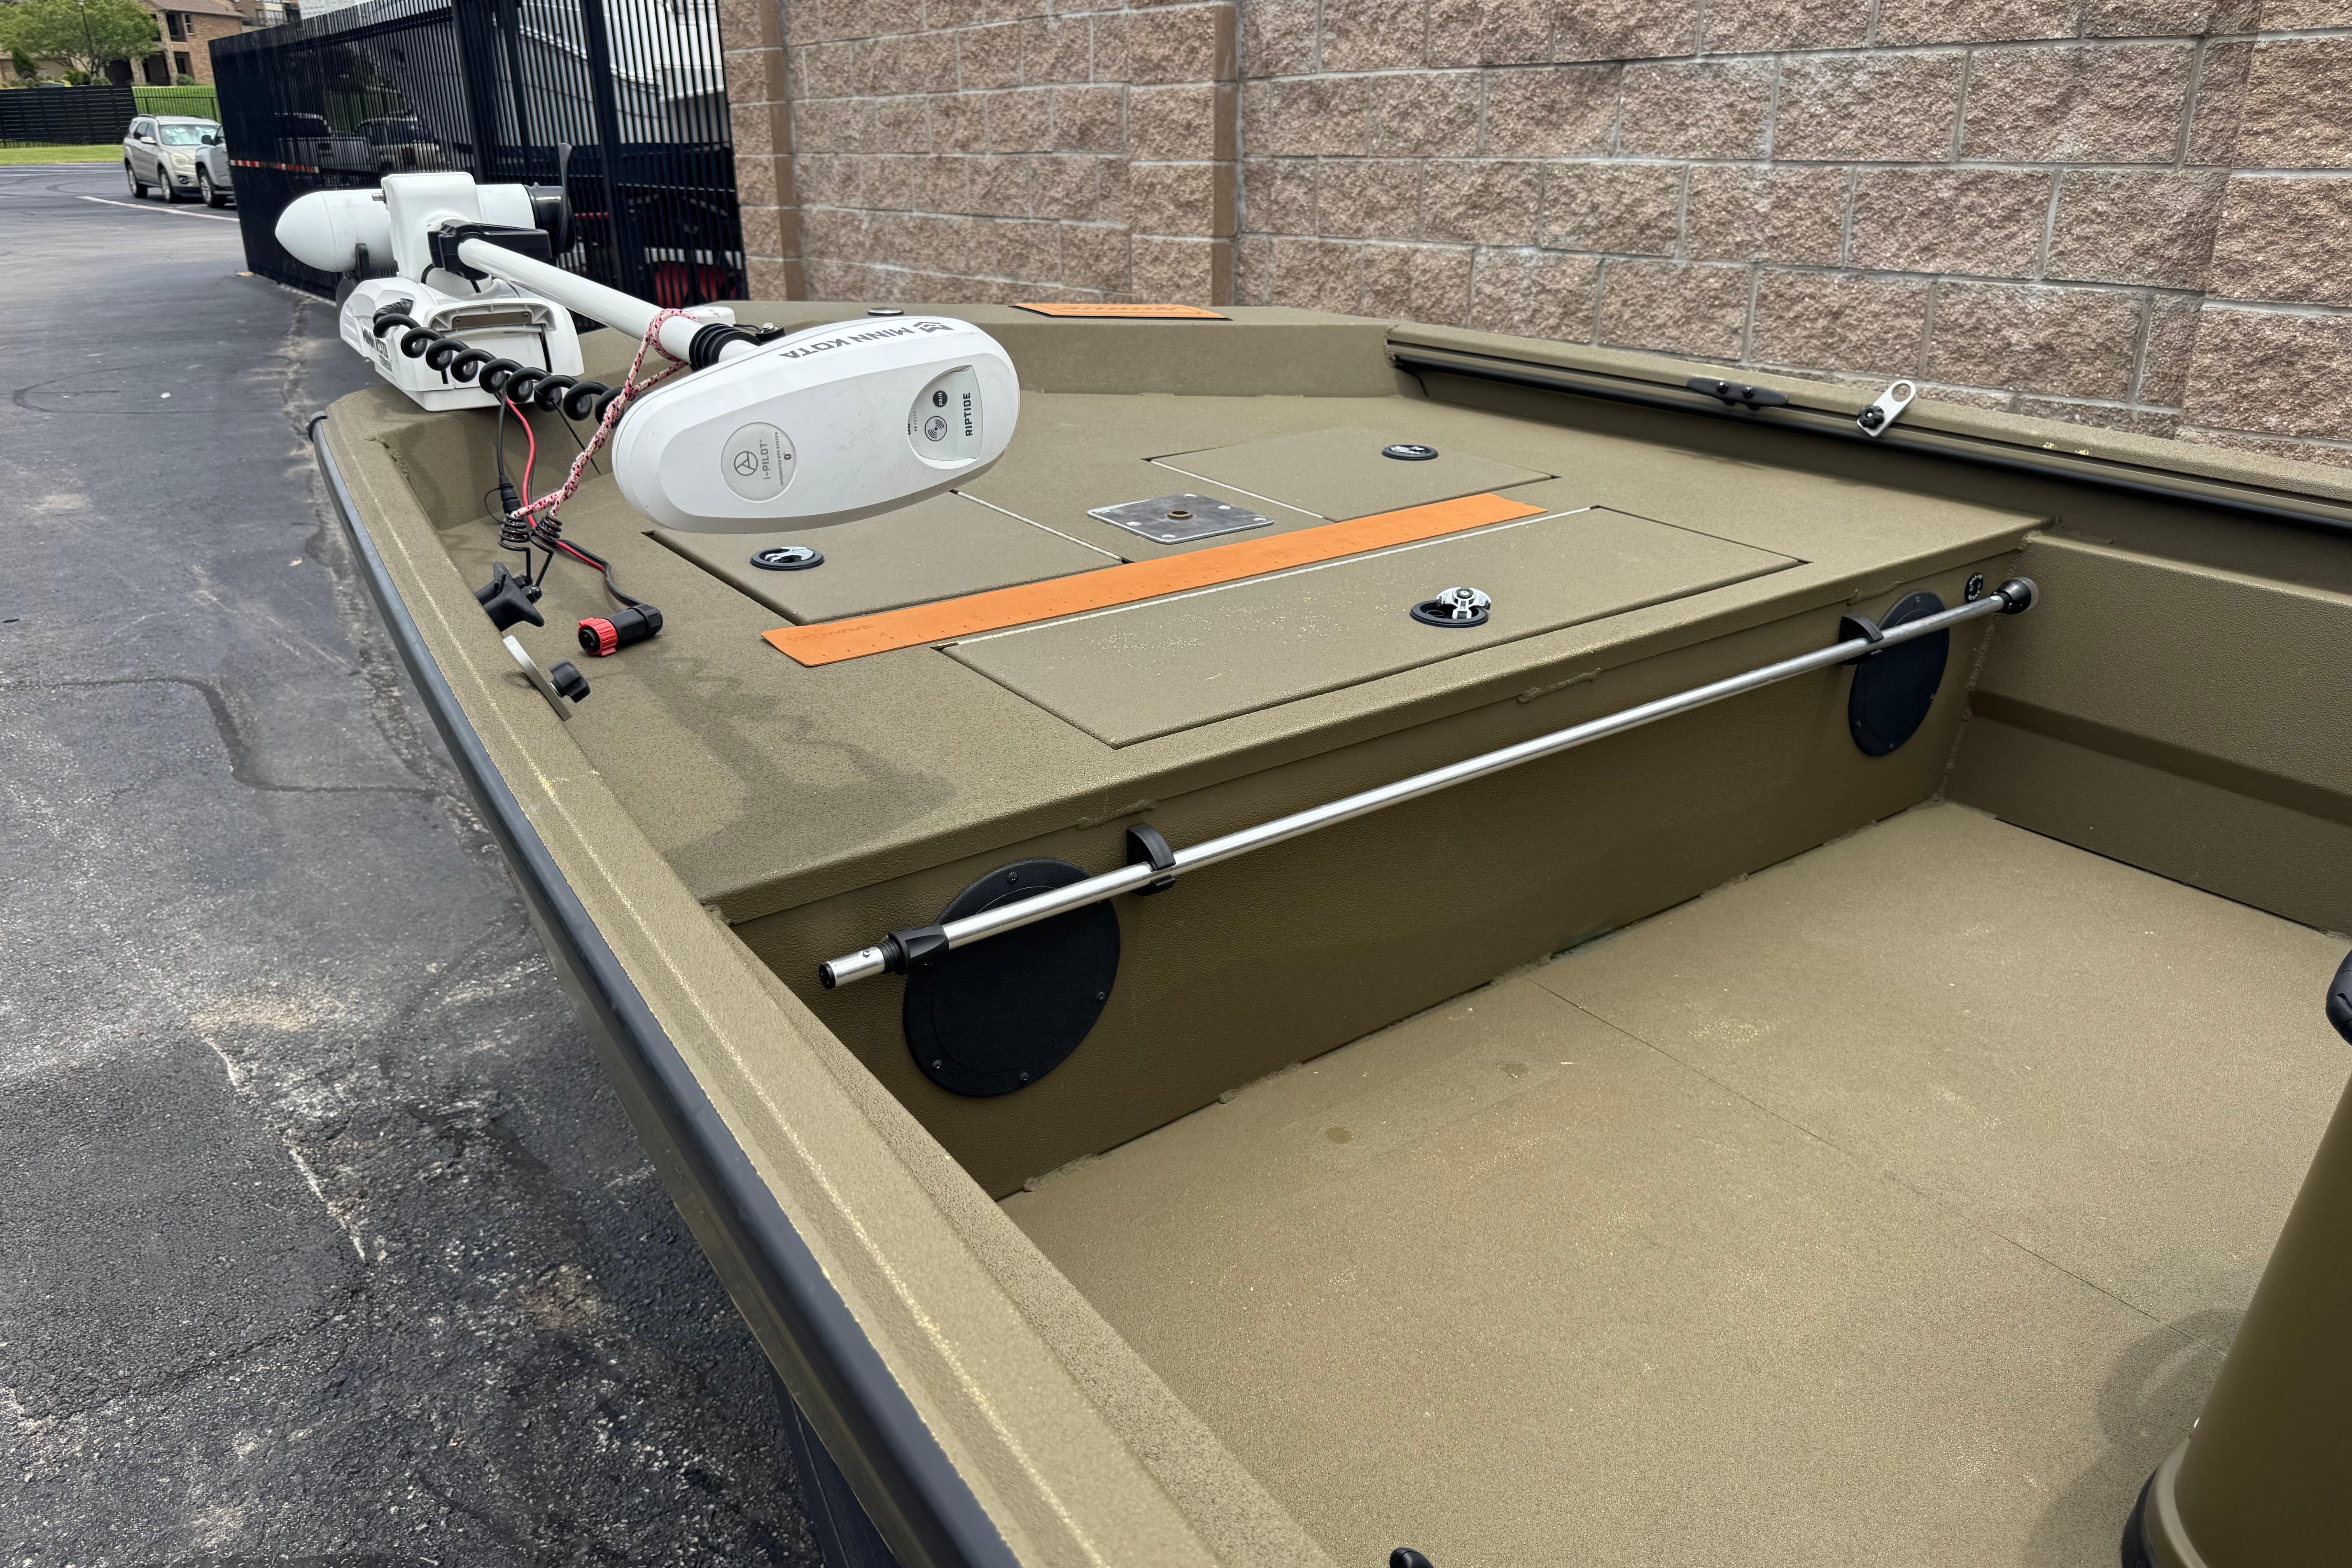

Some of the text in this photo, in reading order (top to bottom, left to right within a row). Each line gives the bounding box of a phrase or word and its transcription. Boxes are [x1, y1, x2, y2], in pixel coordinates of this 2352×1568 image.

[778, 327, 915, 359] MINN KOTA
[963, 392, 973, 436] RIPTIDE
